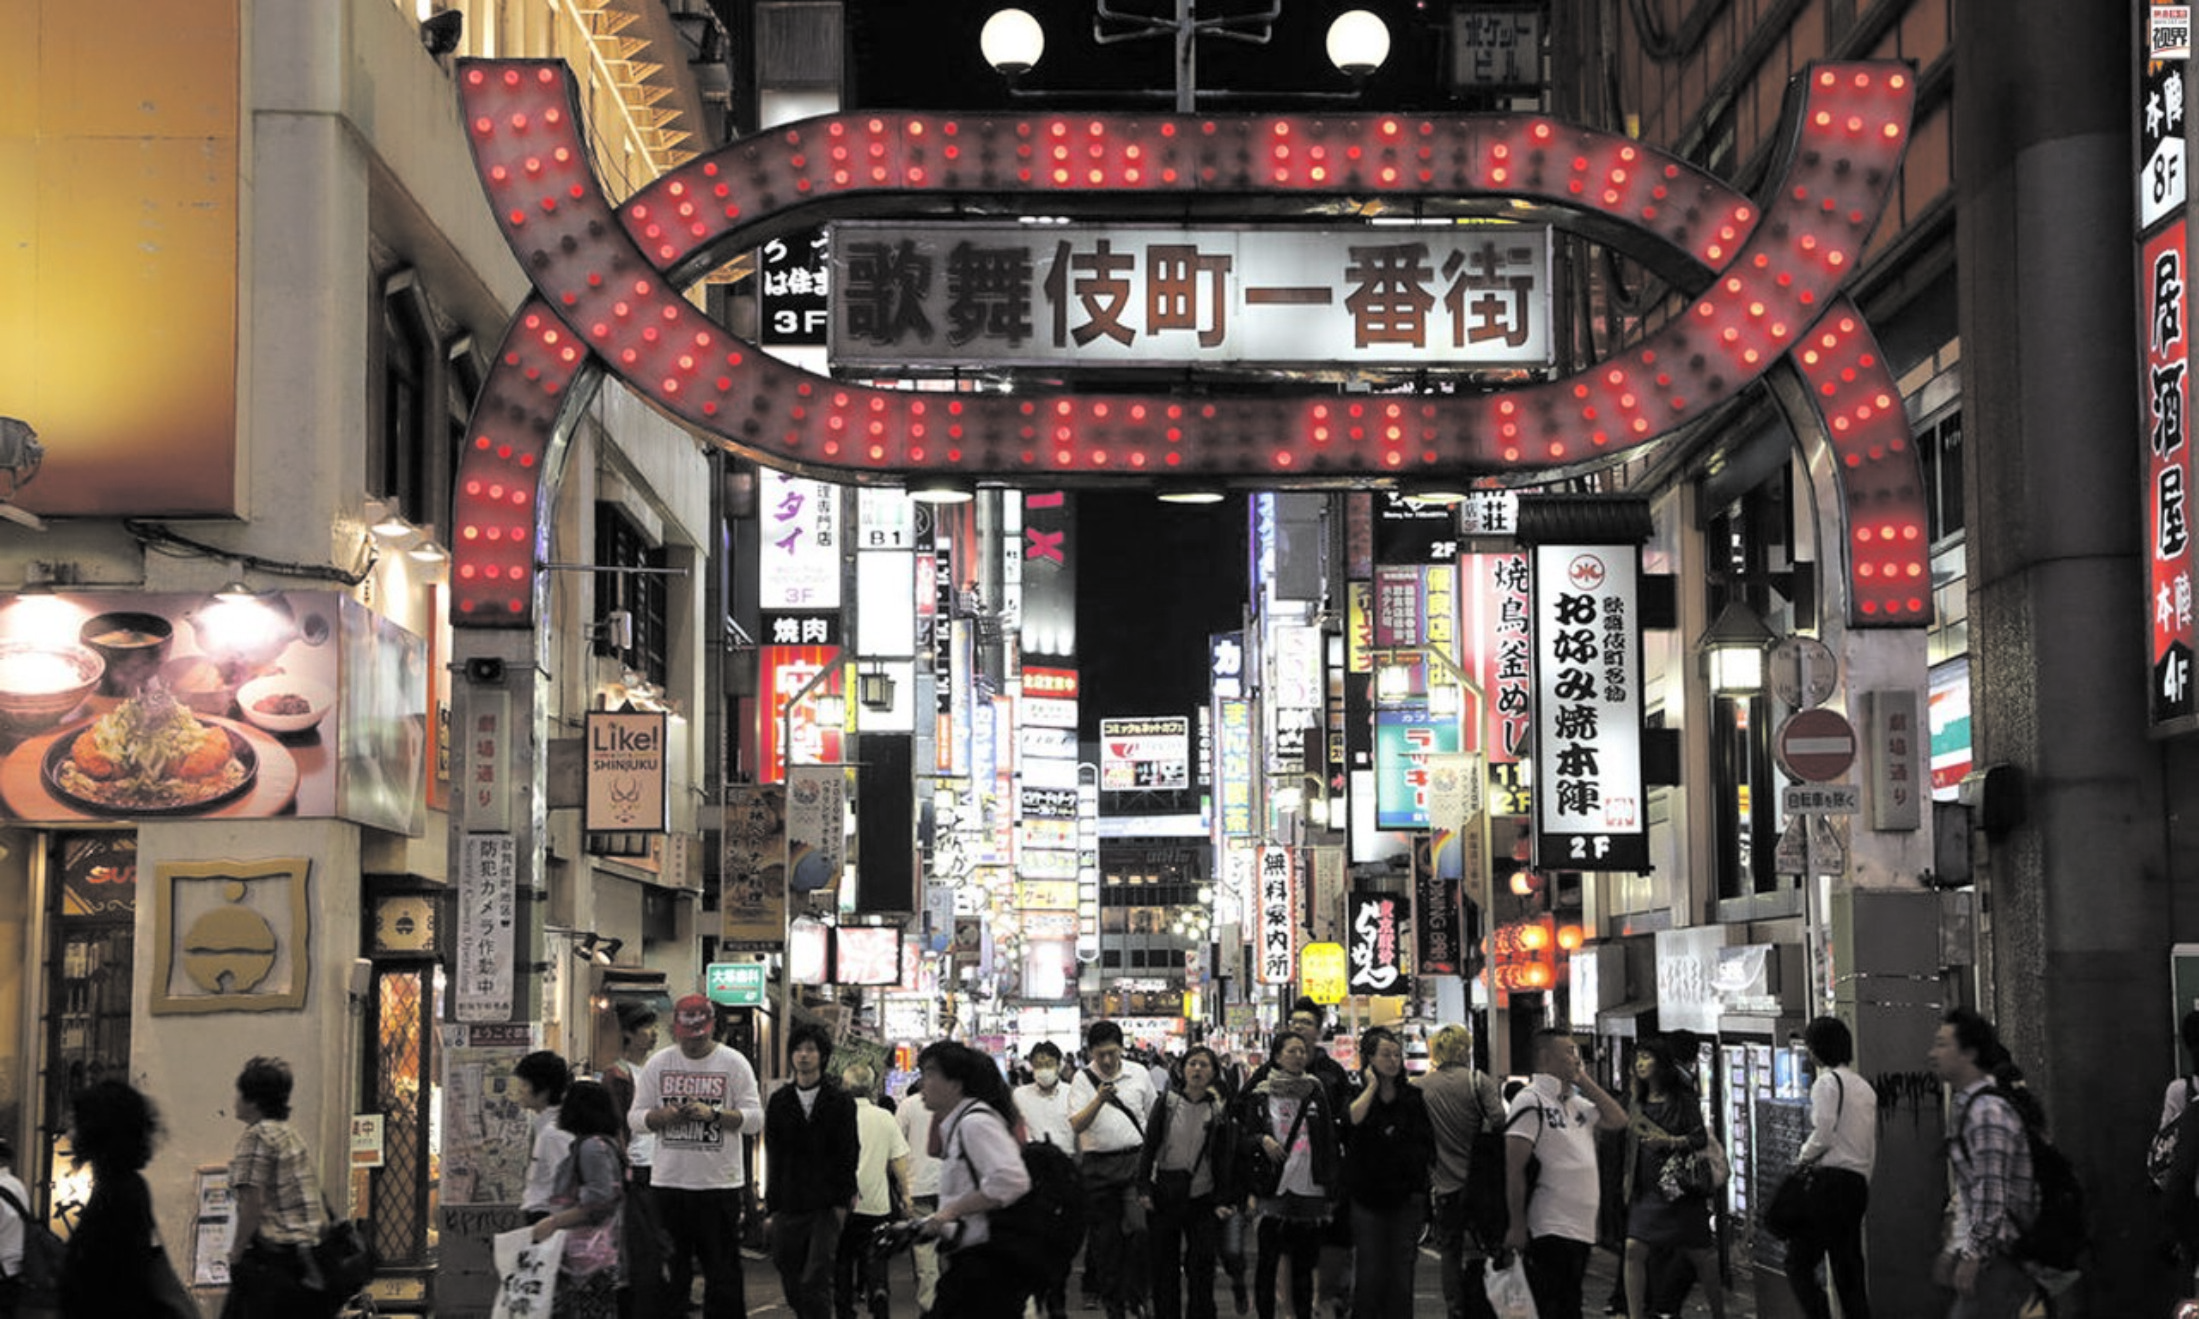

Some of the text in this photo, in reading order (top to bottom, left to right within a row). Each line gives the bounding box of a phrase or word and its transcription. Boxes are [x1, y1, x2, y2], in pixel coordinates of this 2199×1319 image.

[2153, 153, 2178, 203] 8F
[845, 240, 1535, 350] 歌舞伎町一番街
[774, 310, 828, 334] 3F
[2150, 249, 2189, 559] 居酒屋
[870, 531, 903, 545] B1
[1431, 542, 1457, 558] 2F
[785, 588, 814, 603] 3F
[773, 617, 828, 643] 焼肉
[2164, 651, 2188, 703] 4F
[593, 722, 659, 751] Like!
[477, 713, 497, 808] 劇場通り
[593, 760, 658, 772] SHINJUKU
[1788, 792, 1854, 809] 自転車を除く
[1570, 837, 1610, 858] 2F
[479, 839, 498, 996] 防犯カメラ作動中
[1264, 853, 1288, 977] 無料案内所
[663, 1076, 723, 1095] BEGINS
